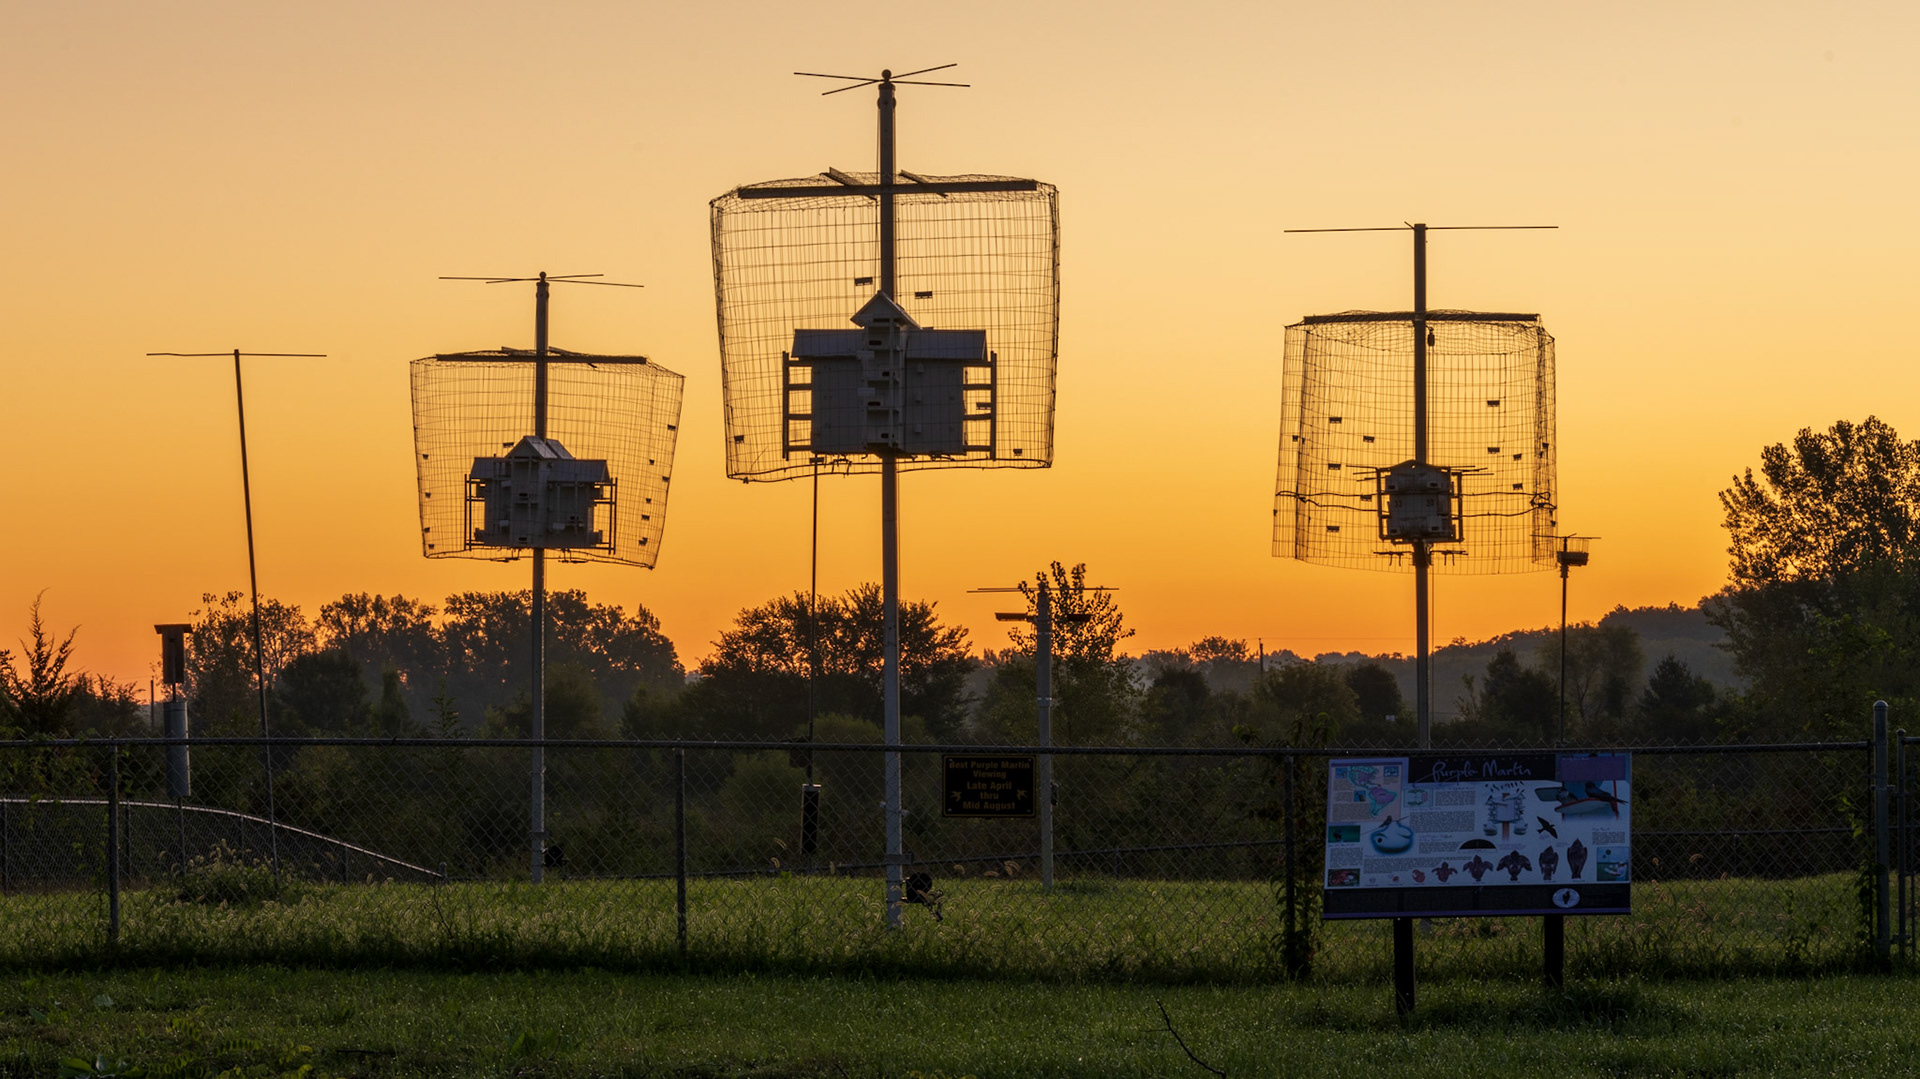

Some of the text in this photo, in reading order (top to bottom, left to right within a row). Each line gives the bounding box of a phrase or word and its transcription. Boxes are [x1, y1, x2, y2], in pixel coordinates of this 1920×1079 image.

[971, 761, 998, 770] Purple
[1001, 761, 1030, 769] Martin
[973, 770, 1006, 779] Viewing
[1430, 760, 1532, 785] Purple Martin
[967, 782, 1012, 791] Late April
[963, 801, 1015, 811] Mid August
